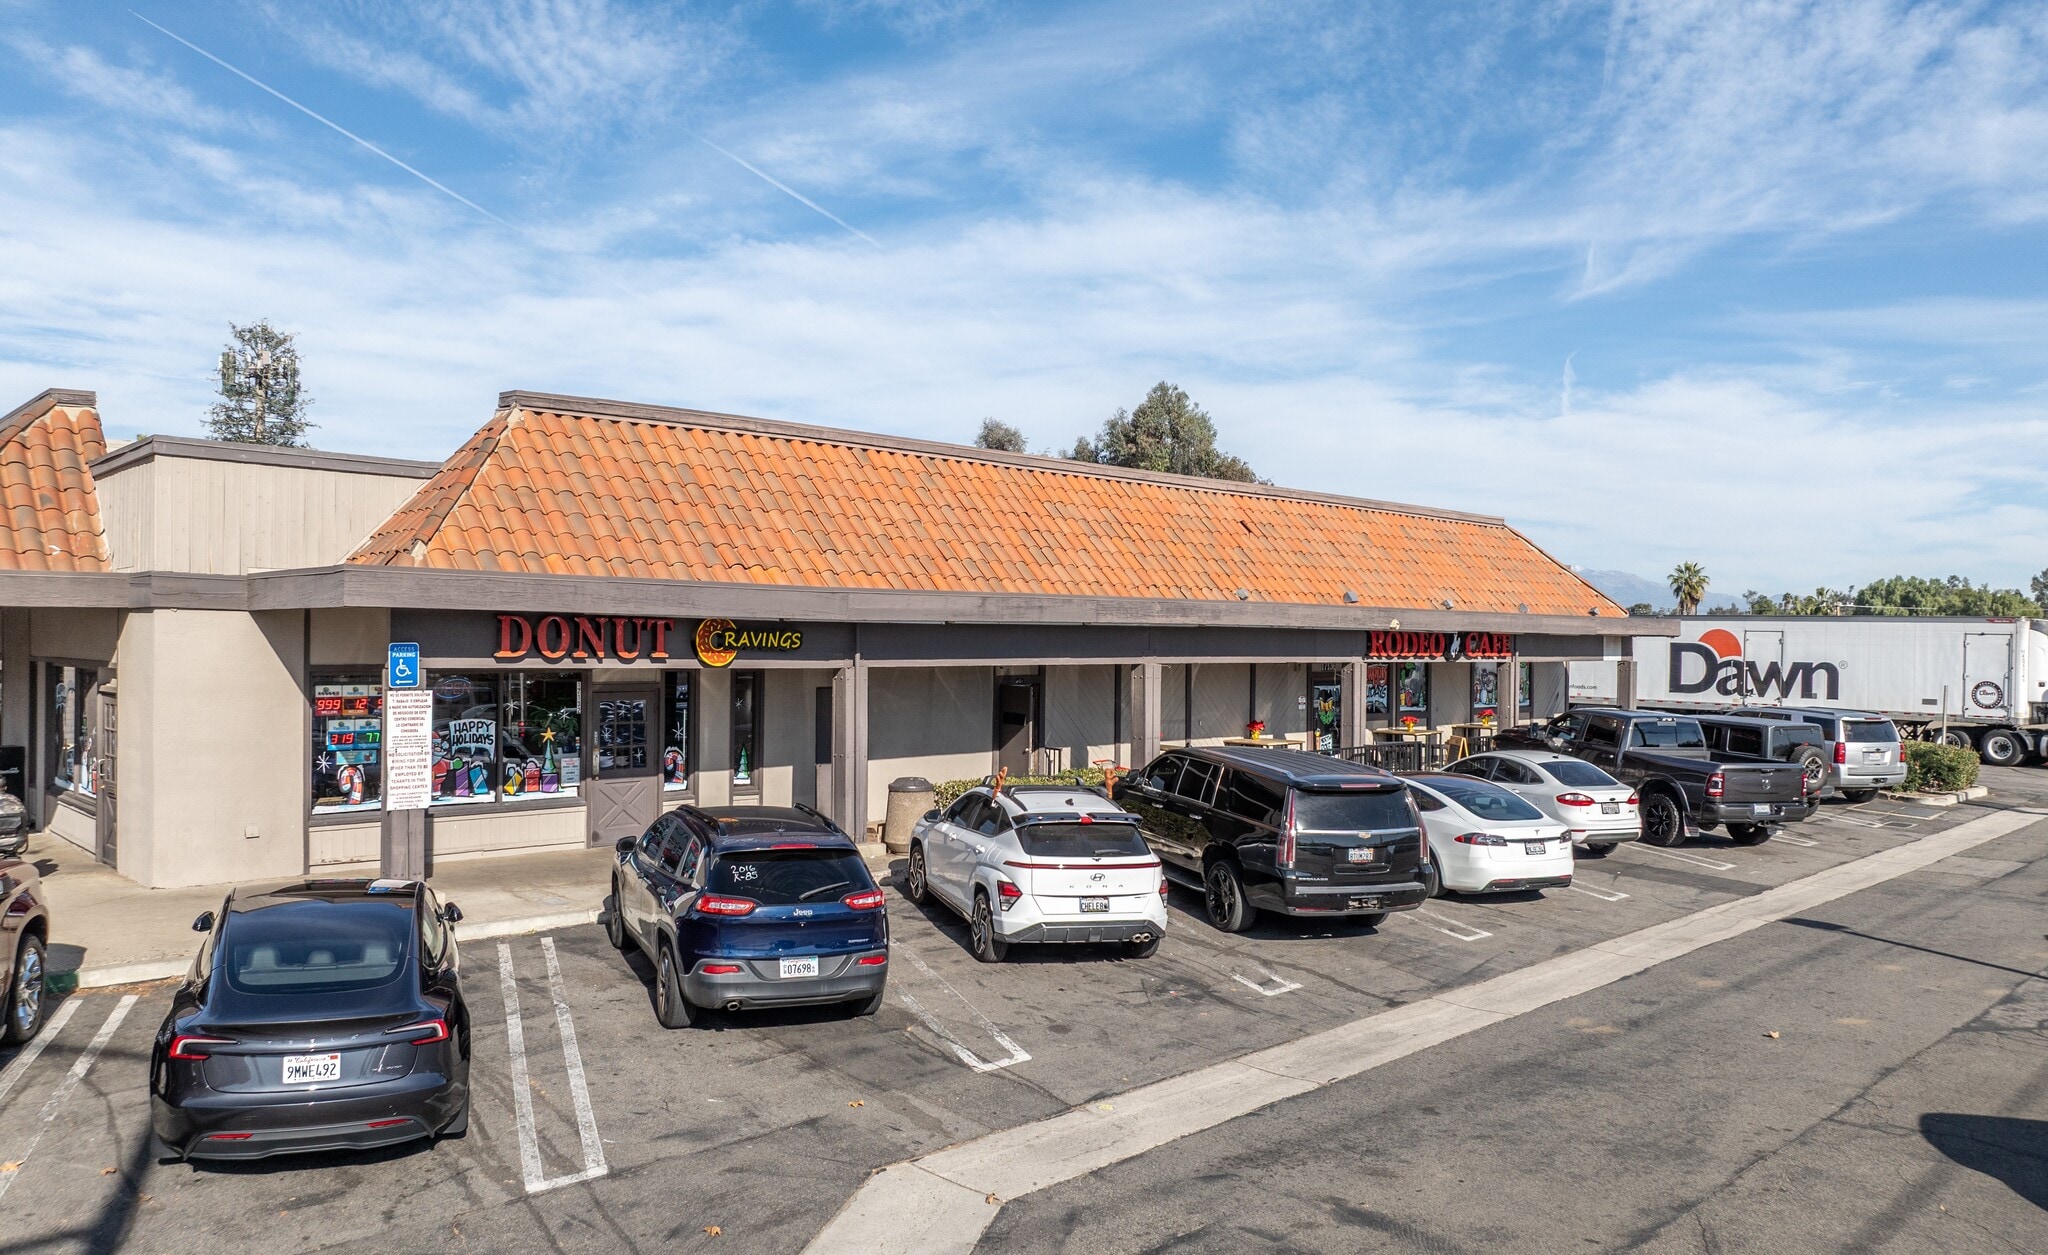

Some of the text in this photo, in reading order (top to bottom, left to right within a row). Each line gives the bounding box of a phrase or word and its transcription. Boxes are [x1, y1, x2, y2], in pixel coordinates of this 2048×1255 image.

[495, 615, 676, 658] DONUT
[709, 630, 801, 651] CRAVINGS
[1368, 631, 1513, 657] RODEO CAFE
[1669, 642, 1839, 700] Dawn
[317, 699, 341, 710] 999
[355, 698, 367, 709] 12
[453, 720, 493, 734] HAPPY
[331, 733, 354, 744] 319
[366, 732, 380, 743] 77
[452, 733, 494, 746] HOLIDAYS
[731, 865, 756, 874] 2016
[793, 908, 813, 916] Jeep
[787, 963, 811, 974] 07698
[295, 1056, 327, 1065] California
[287, 1063, 337, 1079] 9MWE492
